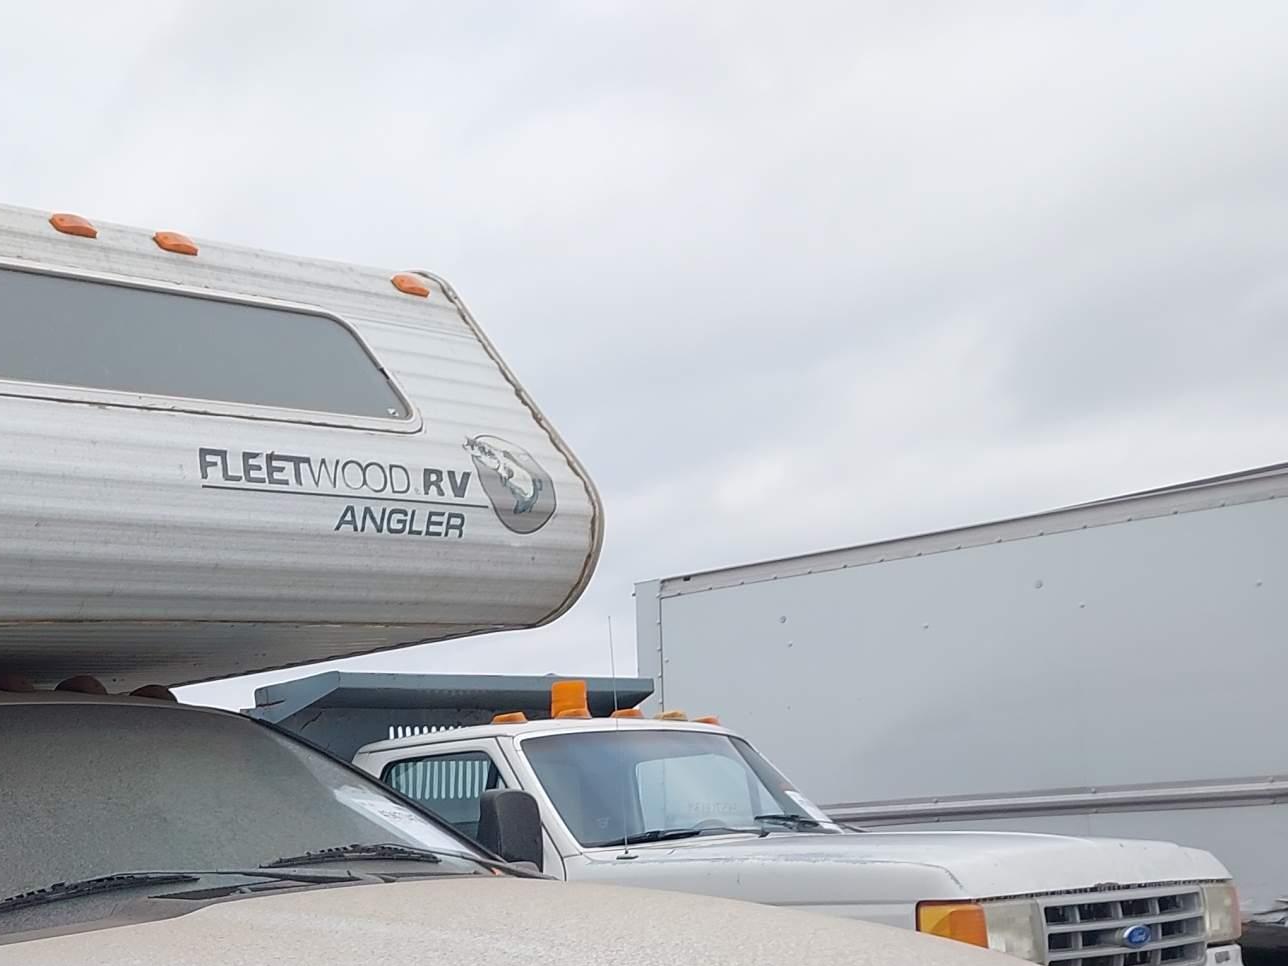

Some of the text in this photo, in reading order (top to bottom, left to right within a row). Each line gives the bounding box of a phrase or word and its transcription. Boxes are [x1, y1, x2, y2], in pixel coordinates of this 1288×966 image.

[199, 447, 472, 499] FLEETWOOD RV
[334, 505, 466, 539] ANGLER
